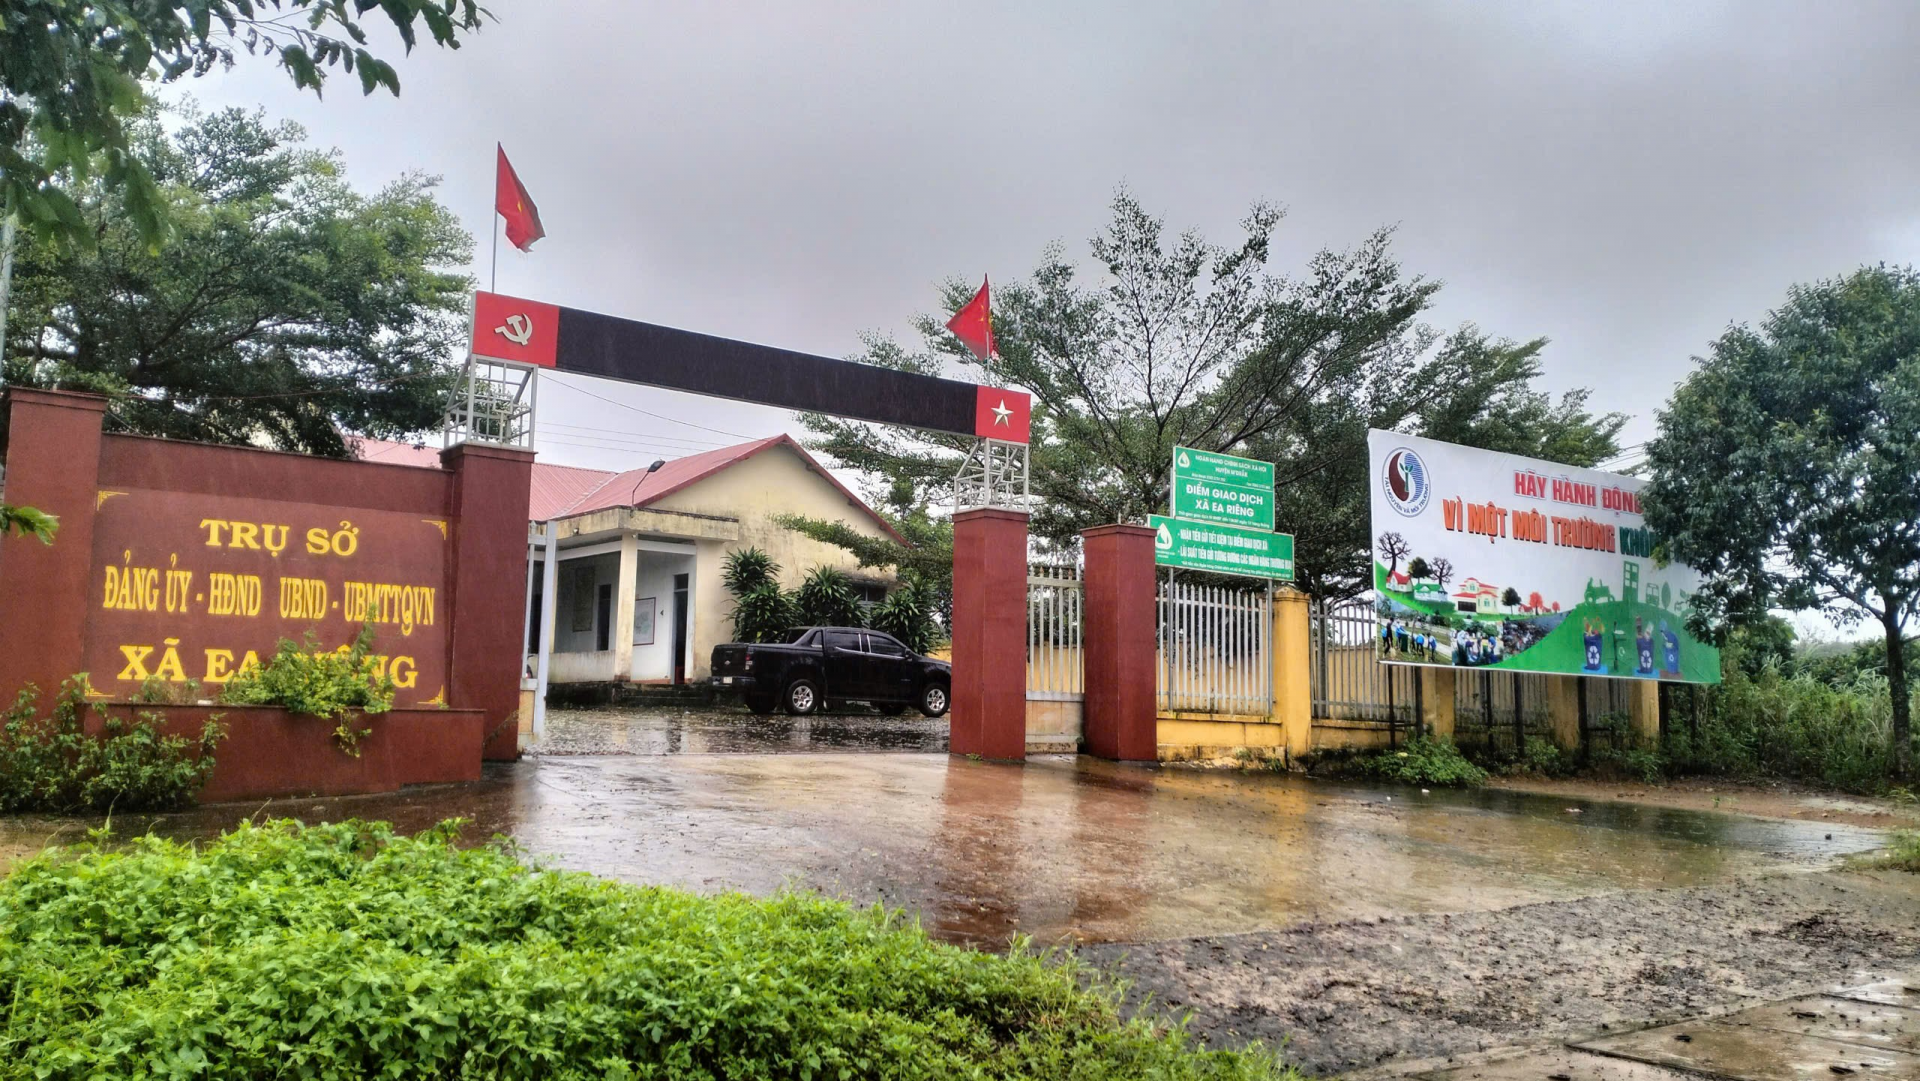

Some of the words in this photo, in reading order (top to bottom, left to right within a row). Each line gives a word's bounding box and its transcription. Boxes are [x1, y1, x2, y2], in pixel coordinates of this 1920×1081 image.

[1186, 482, 1210, 497] ĐIỂM
[1212, 488, 1237, 501] GIAO
[1240, 493, 1264, 506] DỊCH
[1195, 498, 1210, 511] XÃ
[1212, 502, 1224, 513] EA
[1226, 503, 1255, 517] RIÊNG
[1514, 471, 1547, 499] HÃY
[1553, 476, 1596, 507] HÀNH
[199, 518, 290, 558] TRỤ
[306, 520, 360, 557] SỞ
[1442, 495, 1463, 532] VÌ
[1467, 501, 1508, 544] MỘT
[1512, 508, 1547, 544] MÔI
[1551, 516, 1616, 554] TRƯỜNG
[102, 549, 160, 612] ĐẢNG
[165, 552, 193, 613] ỦY
[207, 572, 262, 617] HĐND
[279, 576, 328, 620] UBND
[344, 581, 436, 637] UBMTTQVN
[116, 637, 187, 683] XÃ
